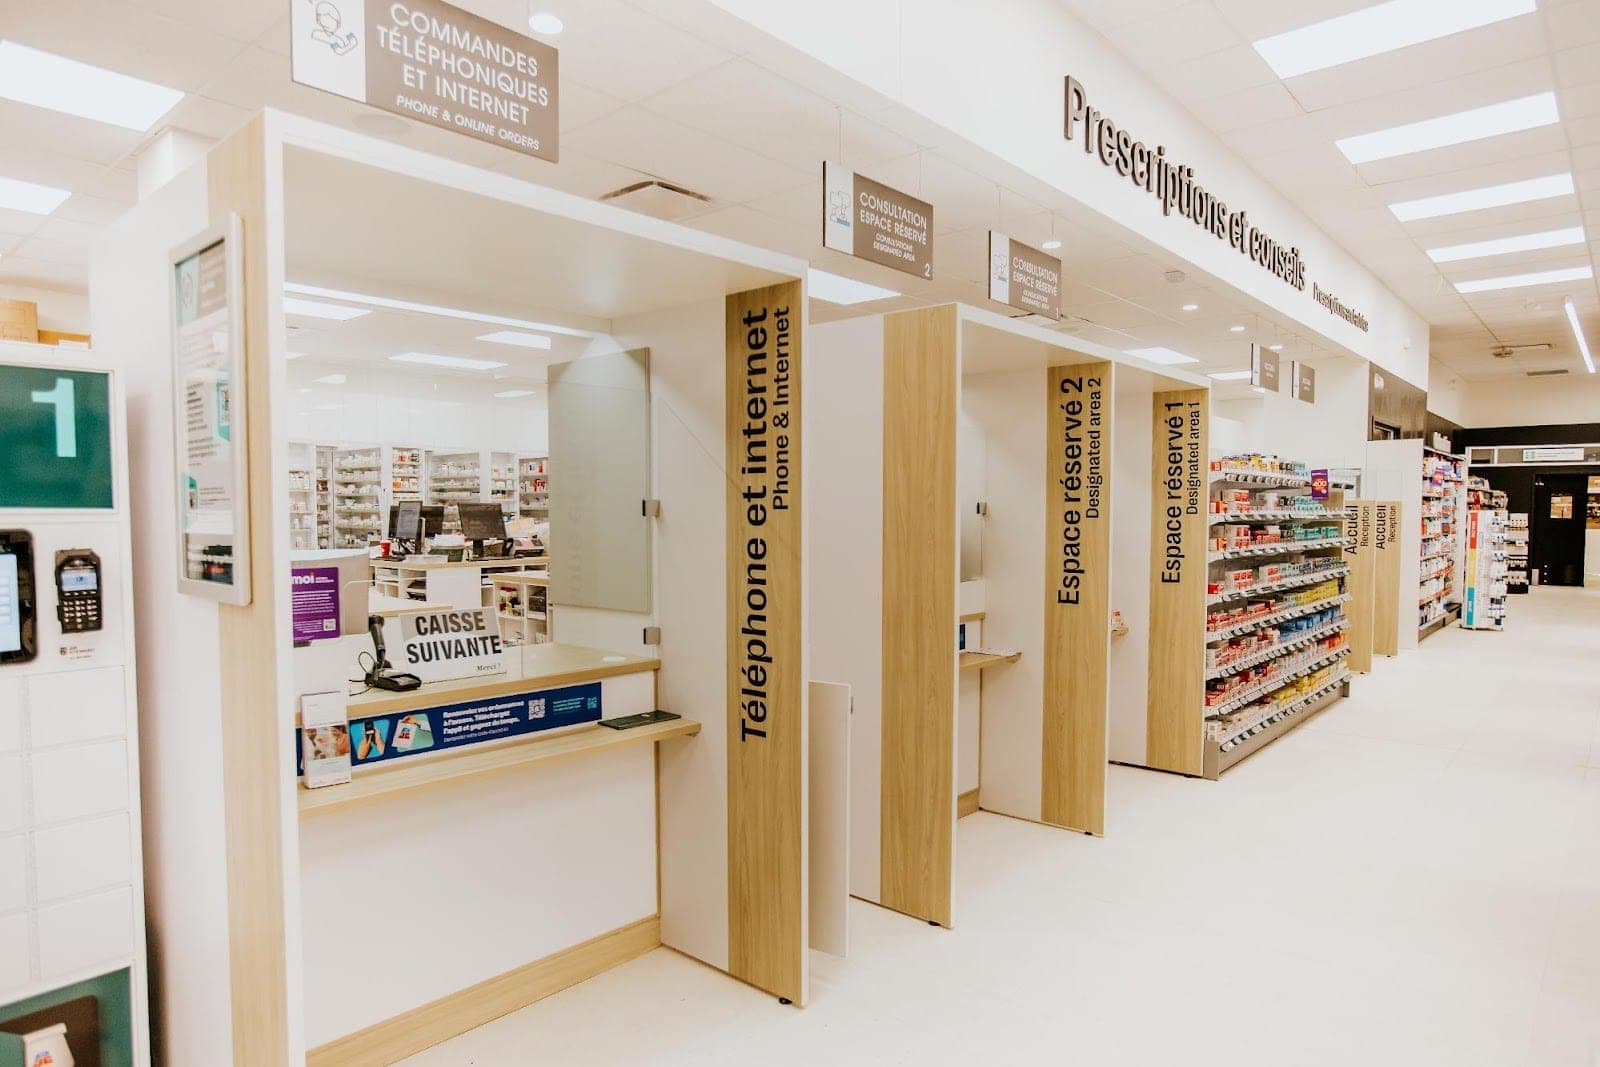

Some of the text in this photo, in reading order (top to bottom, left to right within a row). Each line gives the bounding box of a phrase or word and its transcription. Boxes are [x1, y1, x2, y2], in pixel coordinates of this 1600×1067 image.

[390, 3, 538, 77] COMMANDES
[377, 26, 549, 107] TÉLÉPHONIQUES
[402, 64, 529, 126] ET INTERNET
[397, 95, 540, 150] PHONE & ONLINE ORDERS
[1064, 74, 1306, 291] Prescriptions et conseils
[860, 192, 927, 229] CONSULTATION
[860, 209, 927, 245] ESPACE RÉSERVÉ
[925, 263, 930, 277] 2
[1013, 257, 1058, 284] CONSULTATION
[1013, 271, 1034, 288] ESPACE
[31, 377, 77, 457] 1
[772, 305, 790, 511] Phone & Internet
[1189, 410, 1200, 437] area
[1086, 377, 1102, 518] Designated area 2
[1058, 376, 1085, 605] Espace réservé 2
[1162, 401, 1185, 584] Espace réservé 1
[1186, 442, 1201, 515] Designated
[740, 307, 772, 742] Téléphone et internet
[1344, 505, 1359, 555] Accueil
[1360, 505, 1370, 547] Reception
[1376, 505, 1387, 550] Accueil
[1388, 505, 1397, 542] Reception
[406, 635, 502, 664] SUIVANTE
[415, 611, 486, 636] CAISSE
